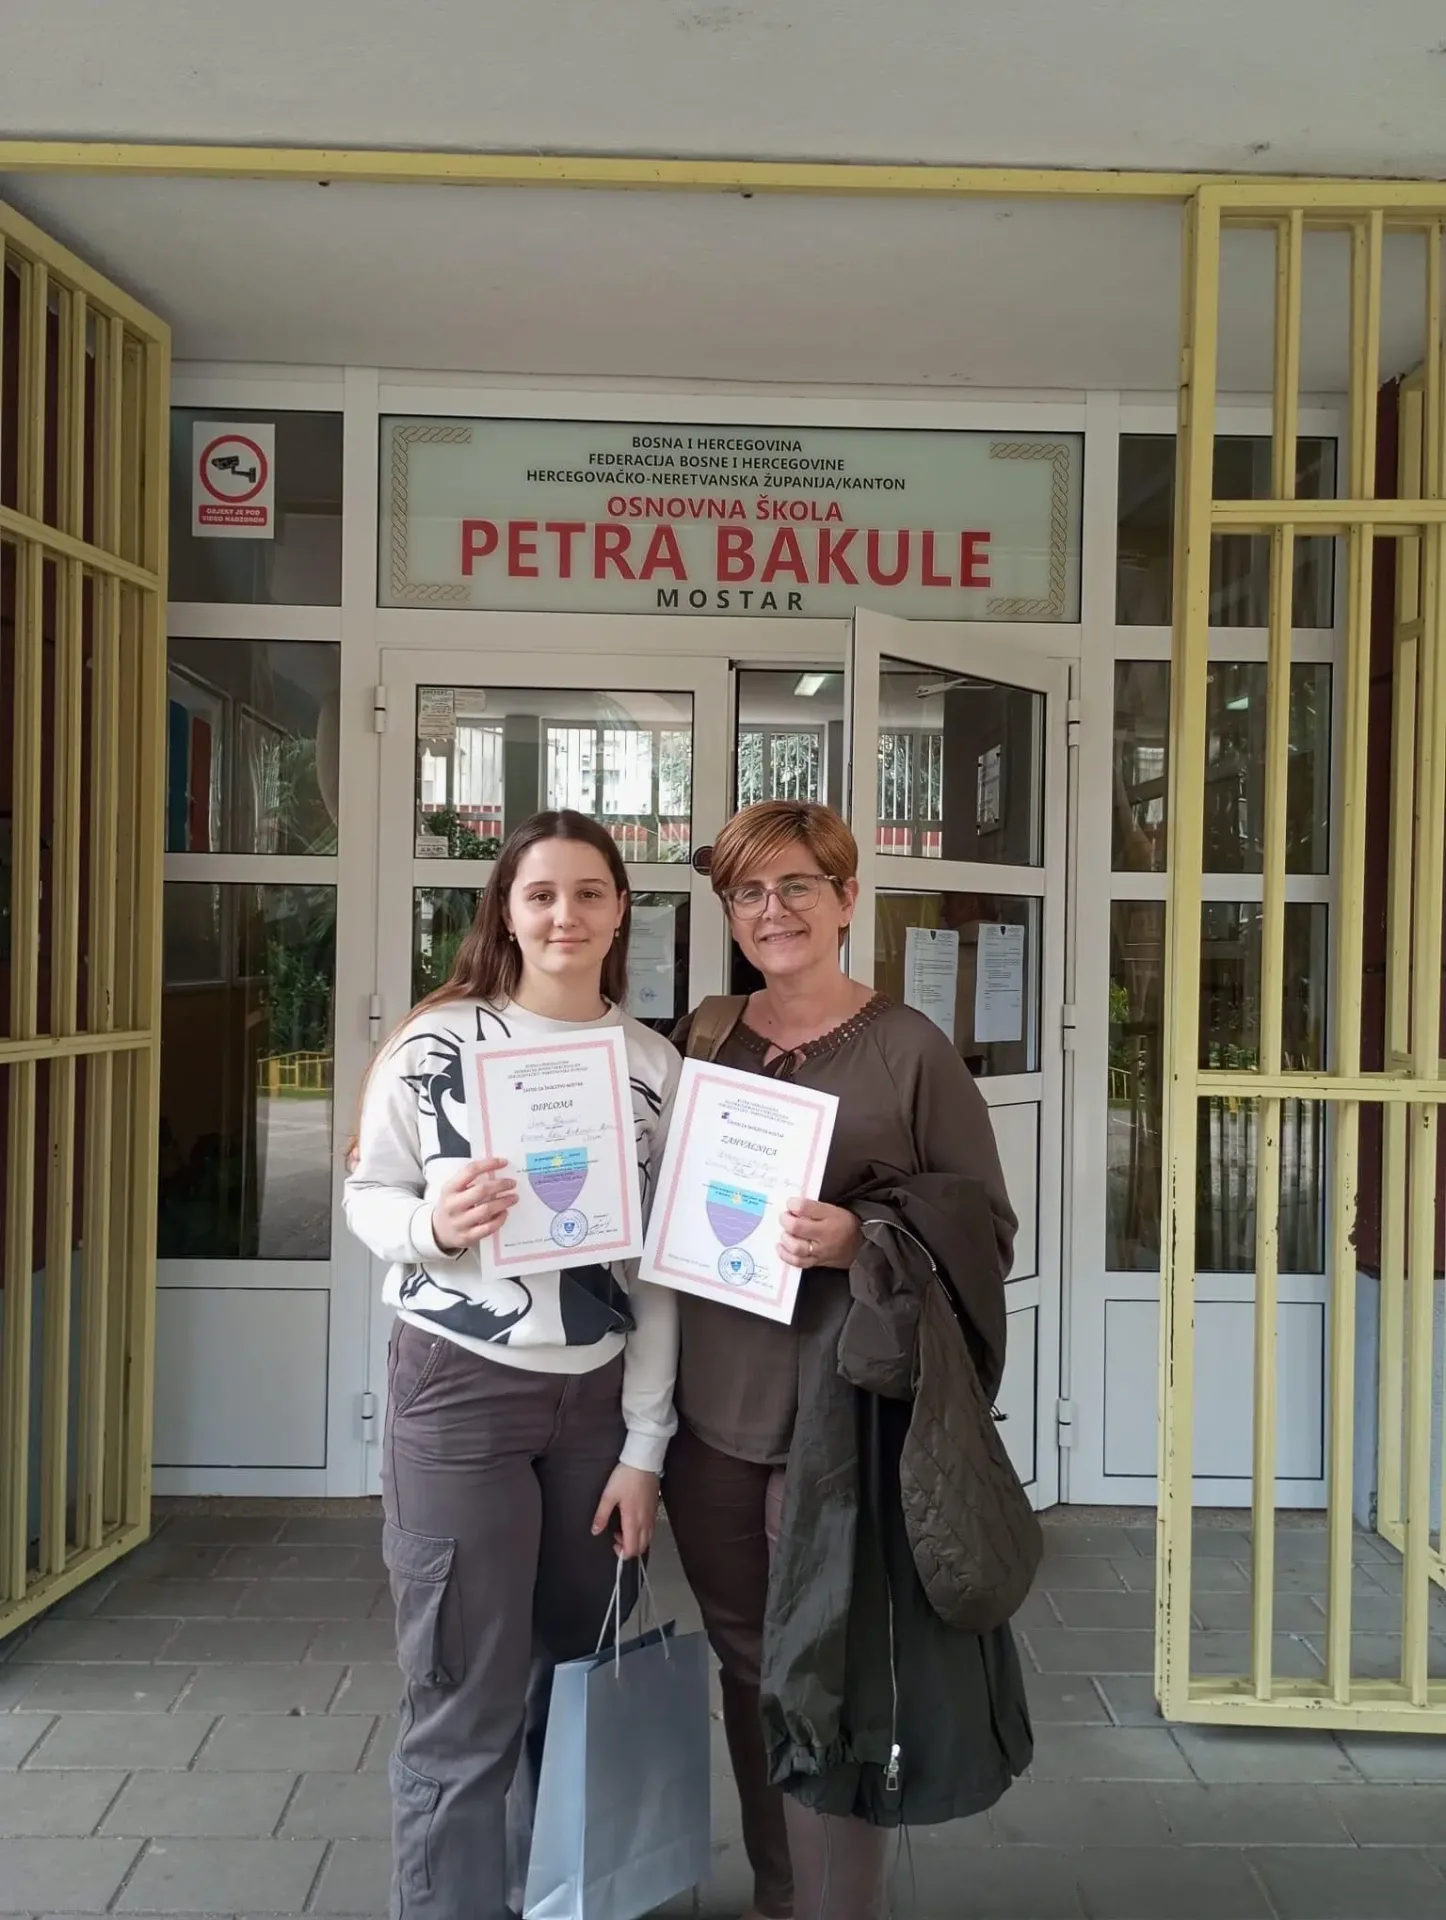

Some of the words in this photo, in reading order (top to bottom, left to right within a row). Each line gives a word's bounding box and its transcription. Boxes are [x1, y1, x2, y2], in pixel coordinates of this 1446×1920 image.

[632, 436, 683, 449] BOSNA
[687, 438, 693, 450] I
[697, 438, 802, 452] HERCEGOVINA
[588, 453, 675, 467] FEDERACIJA
[680, 455, 729, 469] BOSNE
[732, 456, 738, 469] I
[742, 457, 845, 471] HERCEGOVINE
[526, 468, 759, 487] HERCEGOVAČKO-NERETVANSKA
[763, 472, 906, 491] ŽUPANIJA/KANTON
[607, 496, 747, 520] OSNOVNA
[755, 494, 844, 522] ŠKOLA
[461, 519, 688, 581] PETRA
[716, 525, 991, 588] BAKULE
[657, 588, 803, 611] MOSTAR
[531, 1100, 573, 1112] DIPLOMA
[720, 1135, 778, 1156] ZAHVALNICA
